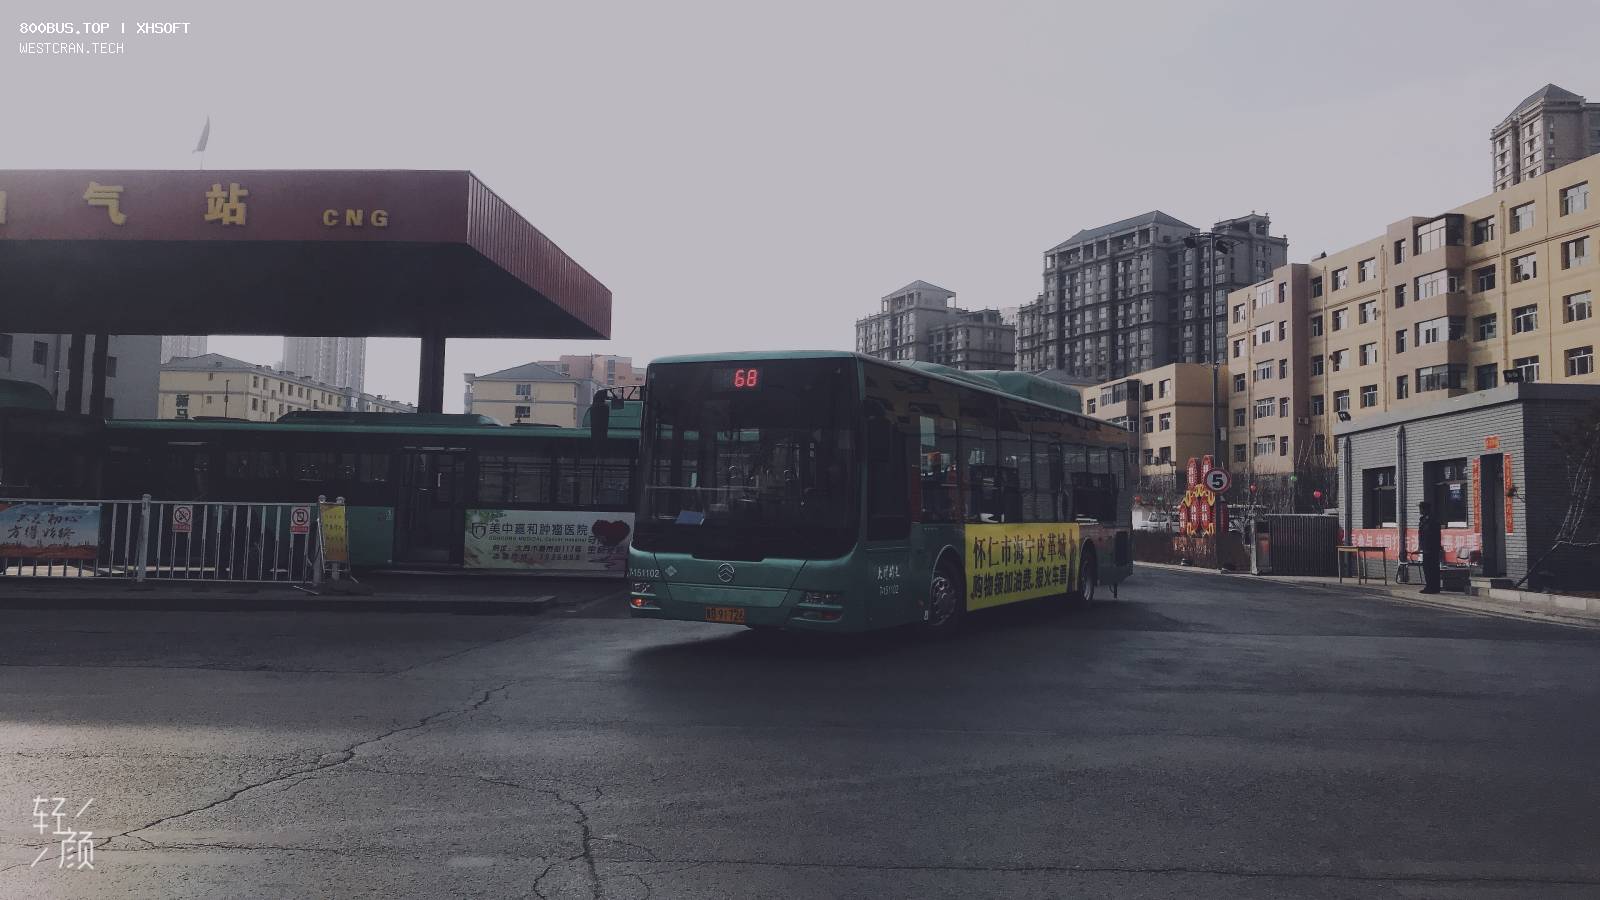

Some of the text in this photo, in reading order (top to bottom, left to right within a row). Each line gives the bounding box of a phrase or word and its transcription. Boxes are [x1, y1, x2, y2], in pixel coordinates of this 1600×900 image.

[322, 208, 389, 227] CNG
[734, 369, 758, 388] 68
[1212, 473, 1224, 489] 5
[488, 522, 589, 536] 美中嘉和肿瘤医院
[973, 532, 1067, 568] 怀仁市海宁皮革城
